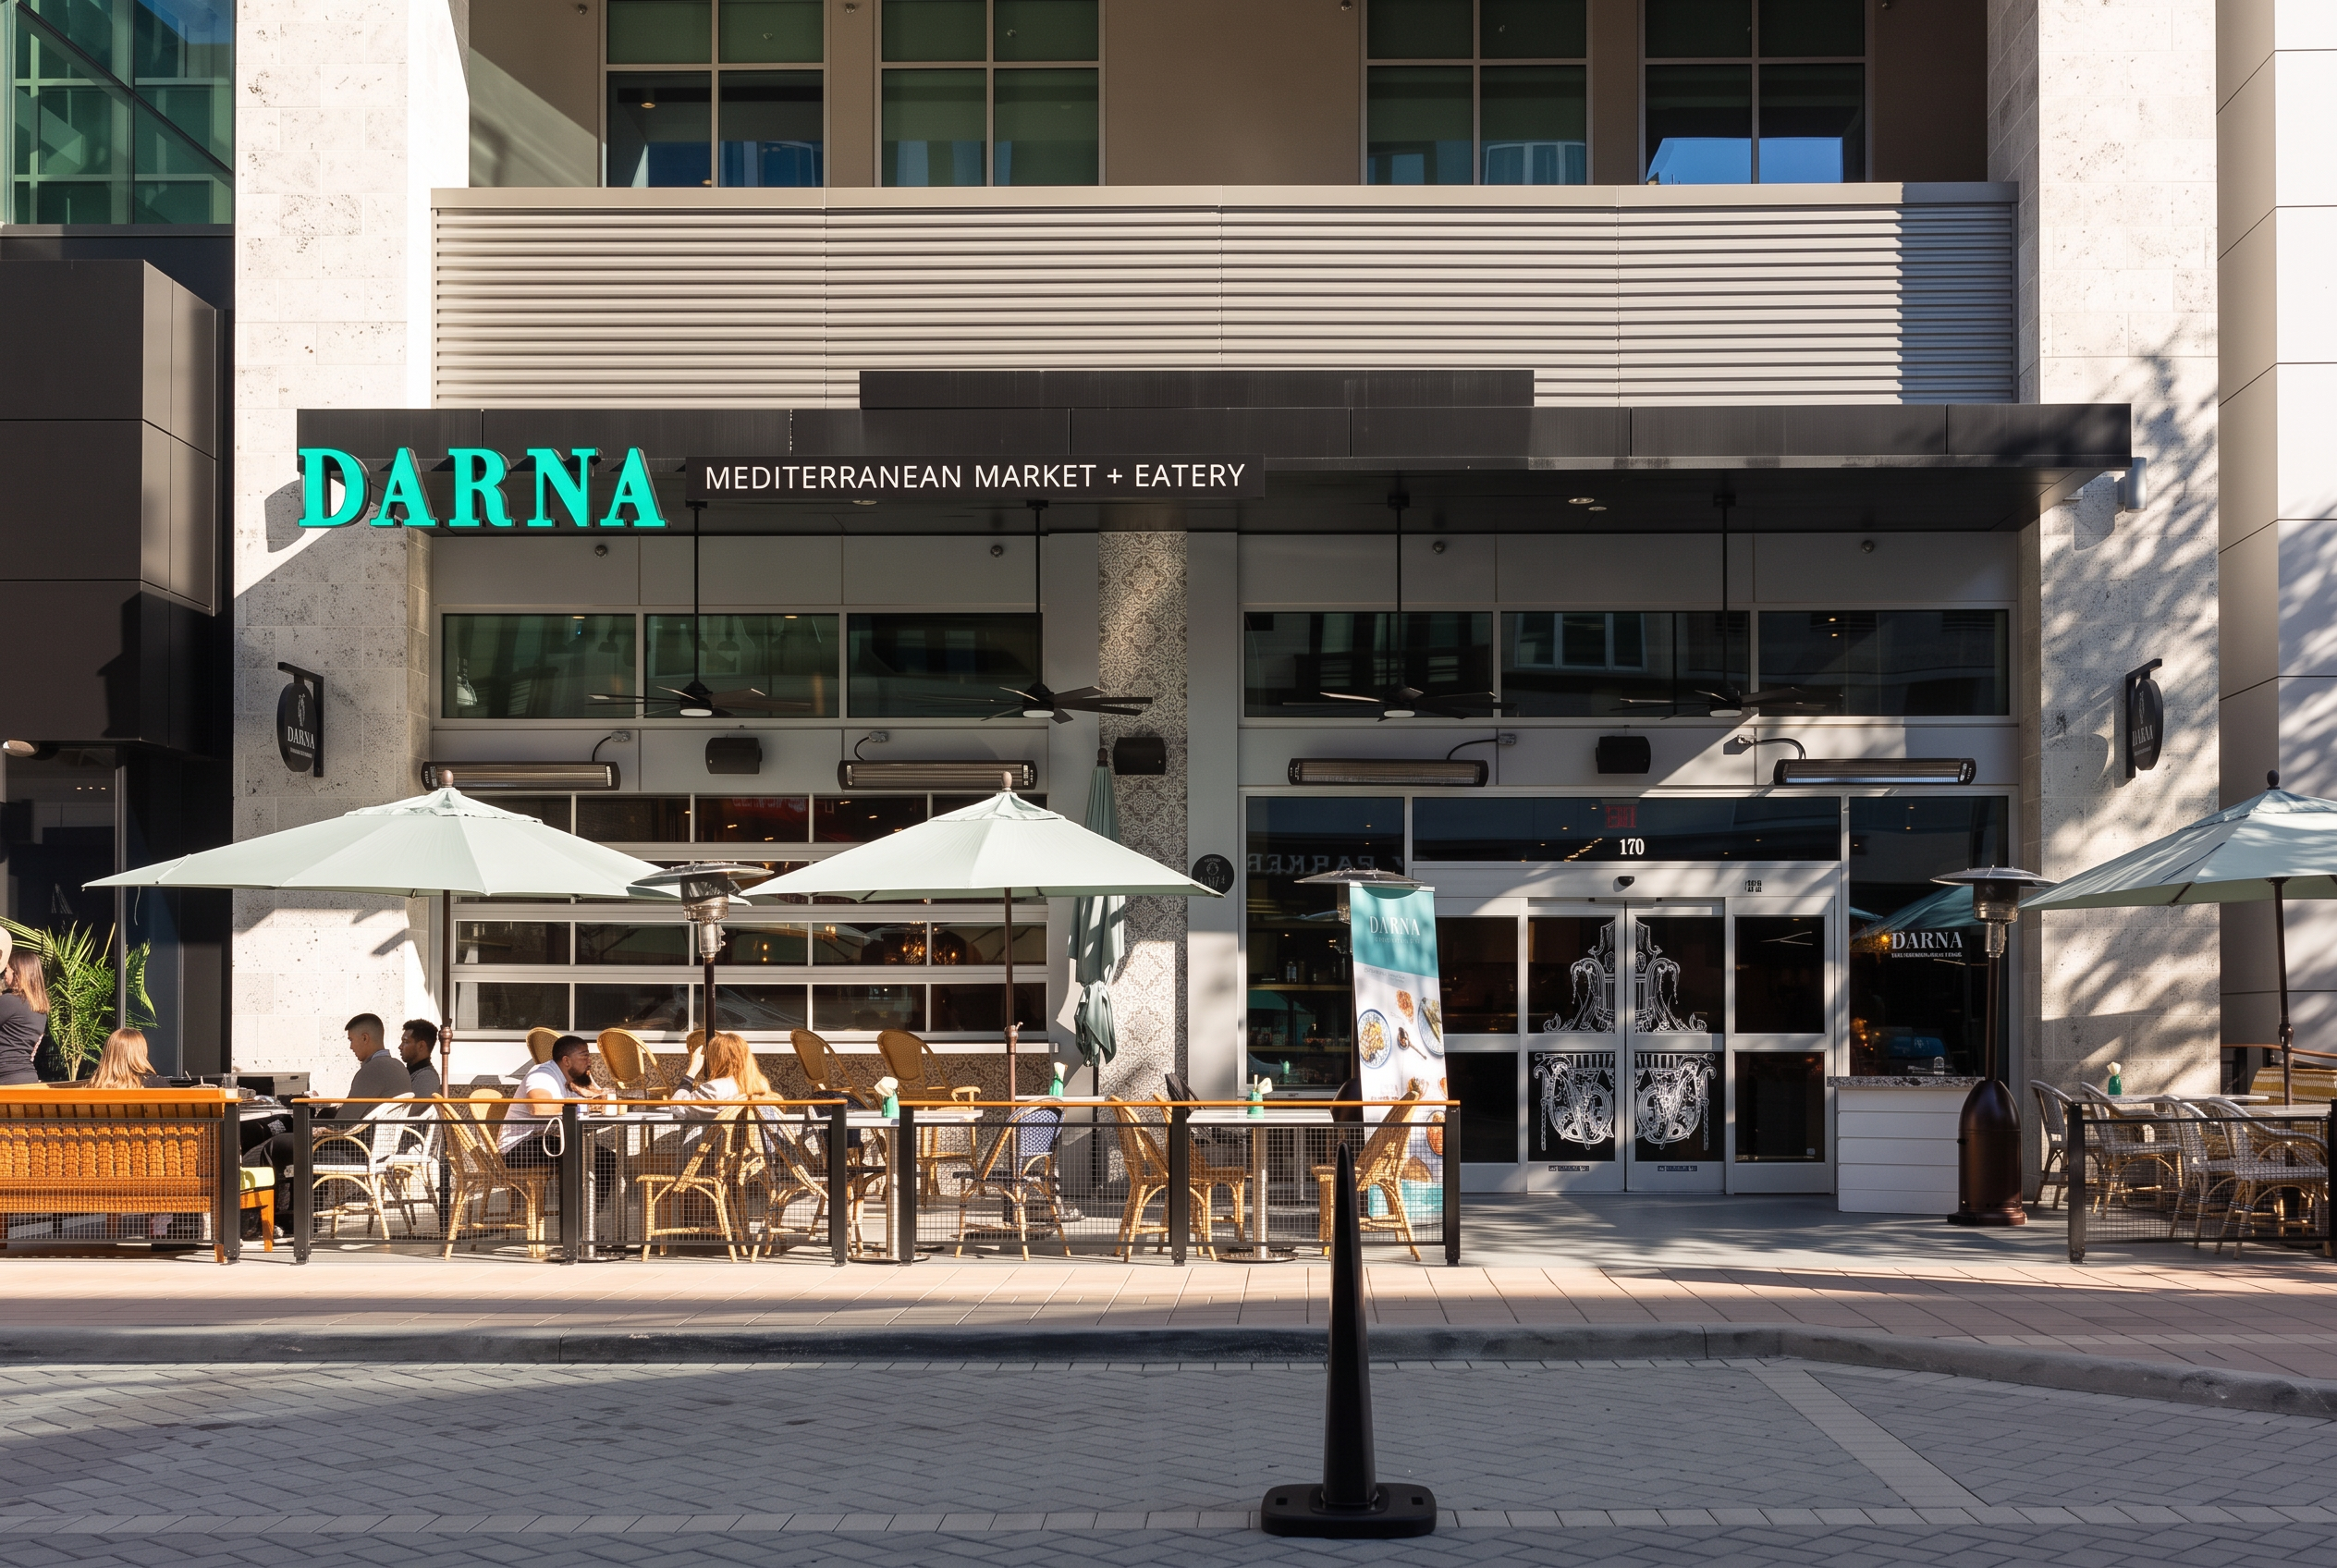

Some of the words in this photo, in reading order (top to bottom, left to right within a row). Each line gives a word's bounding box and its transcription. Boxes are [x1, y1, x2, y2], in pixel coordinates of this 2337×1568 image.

[297, 447, 667, 528] DARNA
[705, 465, 961, 490] MEDITERRANEAN
[974, 464, 1098, 489] MARKET
[1107, 468, 1124, 484] +
[1134, 463, 1246, 487] EATERY
[1619, 838, 1646, 856] 170
[1369, 915, 1421, 937] DARNA
[1891, 931, 1963, 949] DARNA
